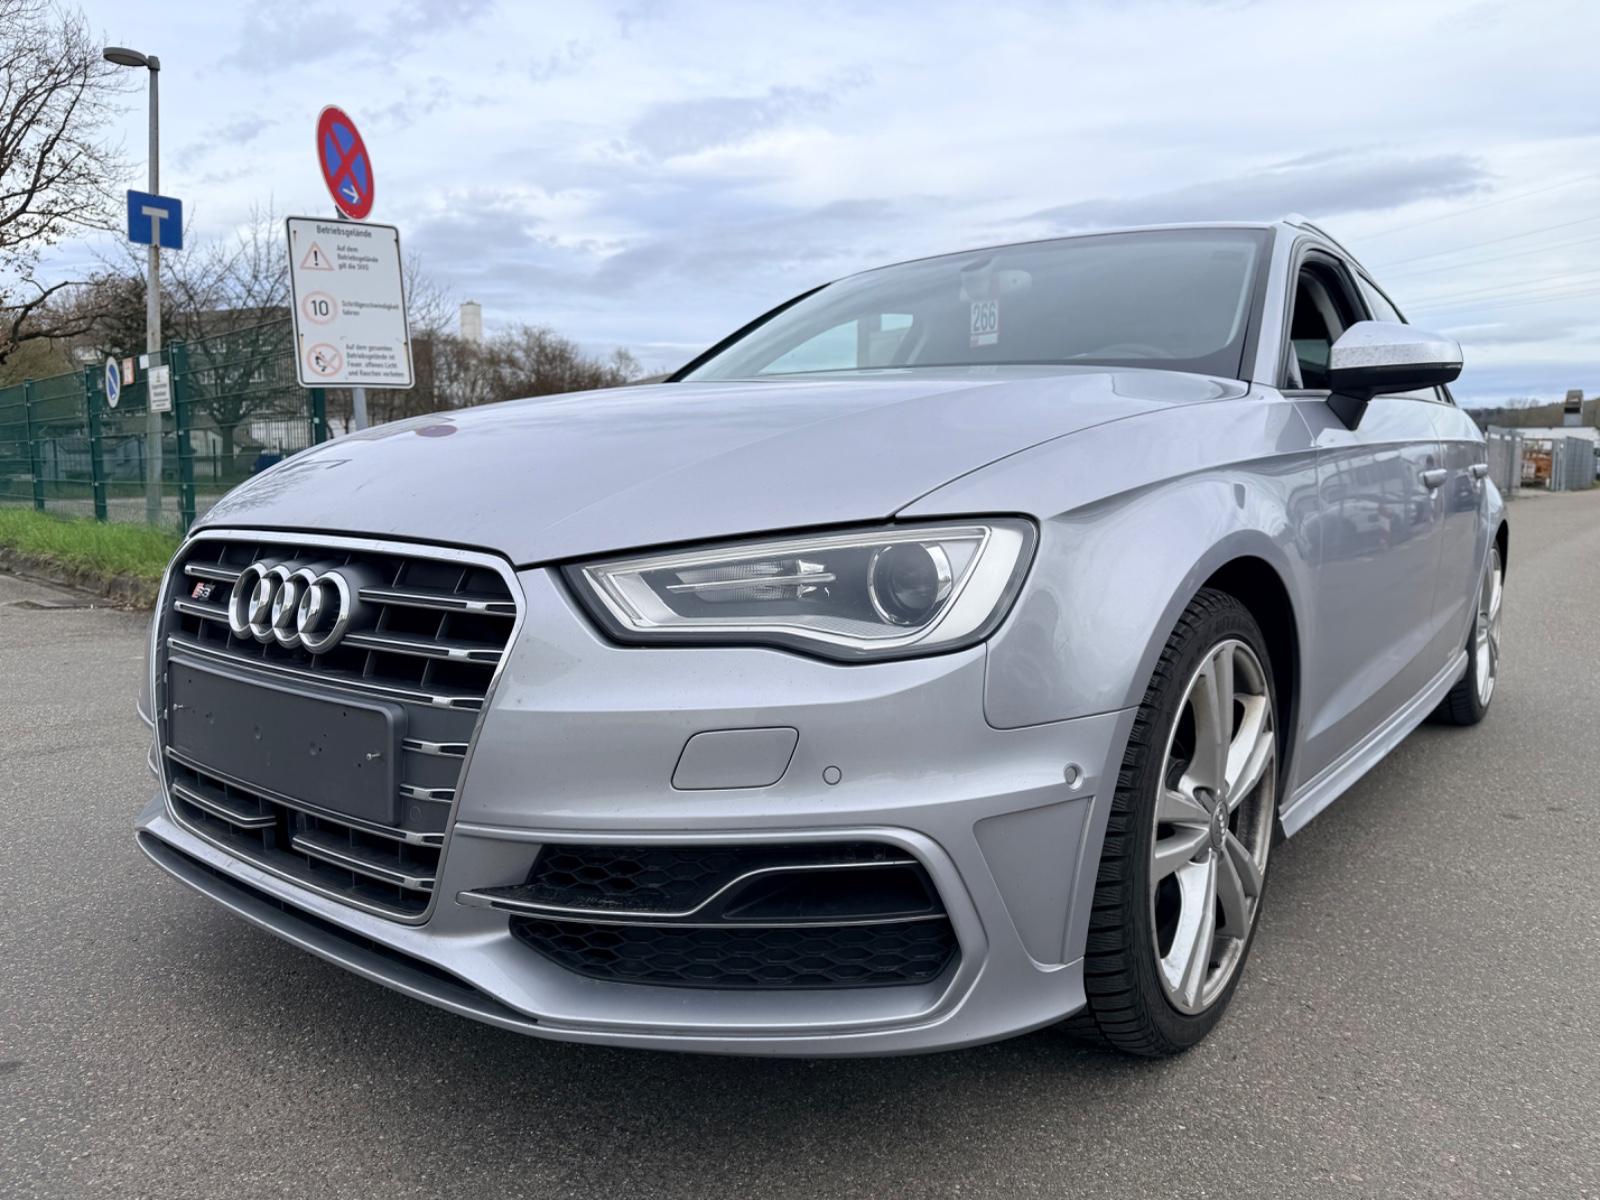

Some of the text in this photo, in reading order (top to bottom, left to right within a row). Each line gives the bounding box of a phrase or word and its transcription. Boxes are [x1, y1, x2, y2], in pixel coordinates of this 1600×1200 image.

[316, 224, 372, 238] Betriebsgelände
[337, 253, 378, 263] Betriebsgelände
[311, 299, 329, 316] 10
[973, 302, 996, 331] 266
[347, 352, 387, 360] Betriebsgelände
[360, 369, 381, 377] Rauchen
